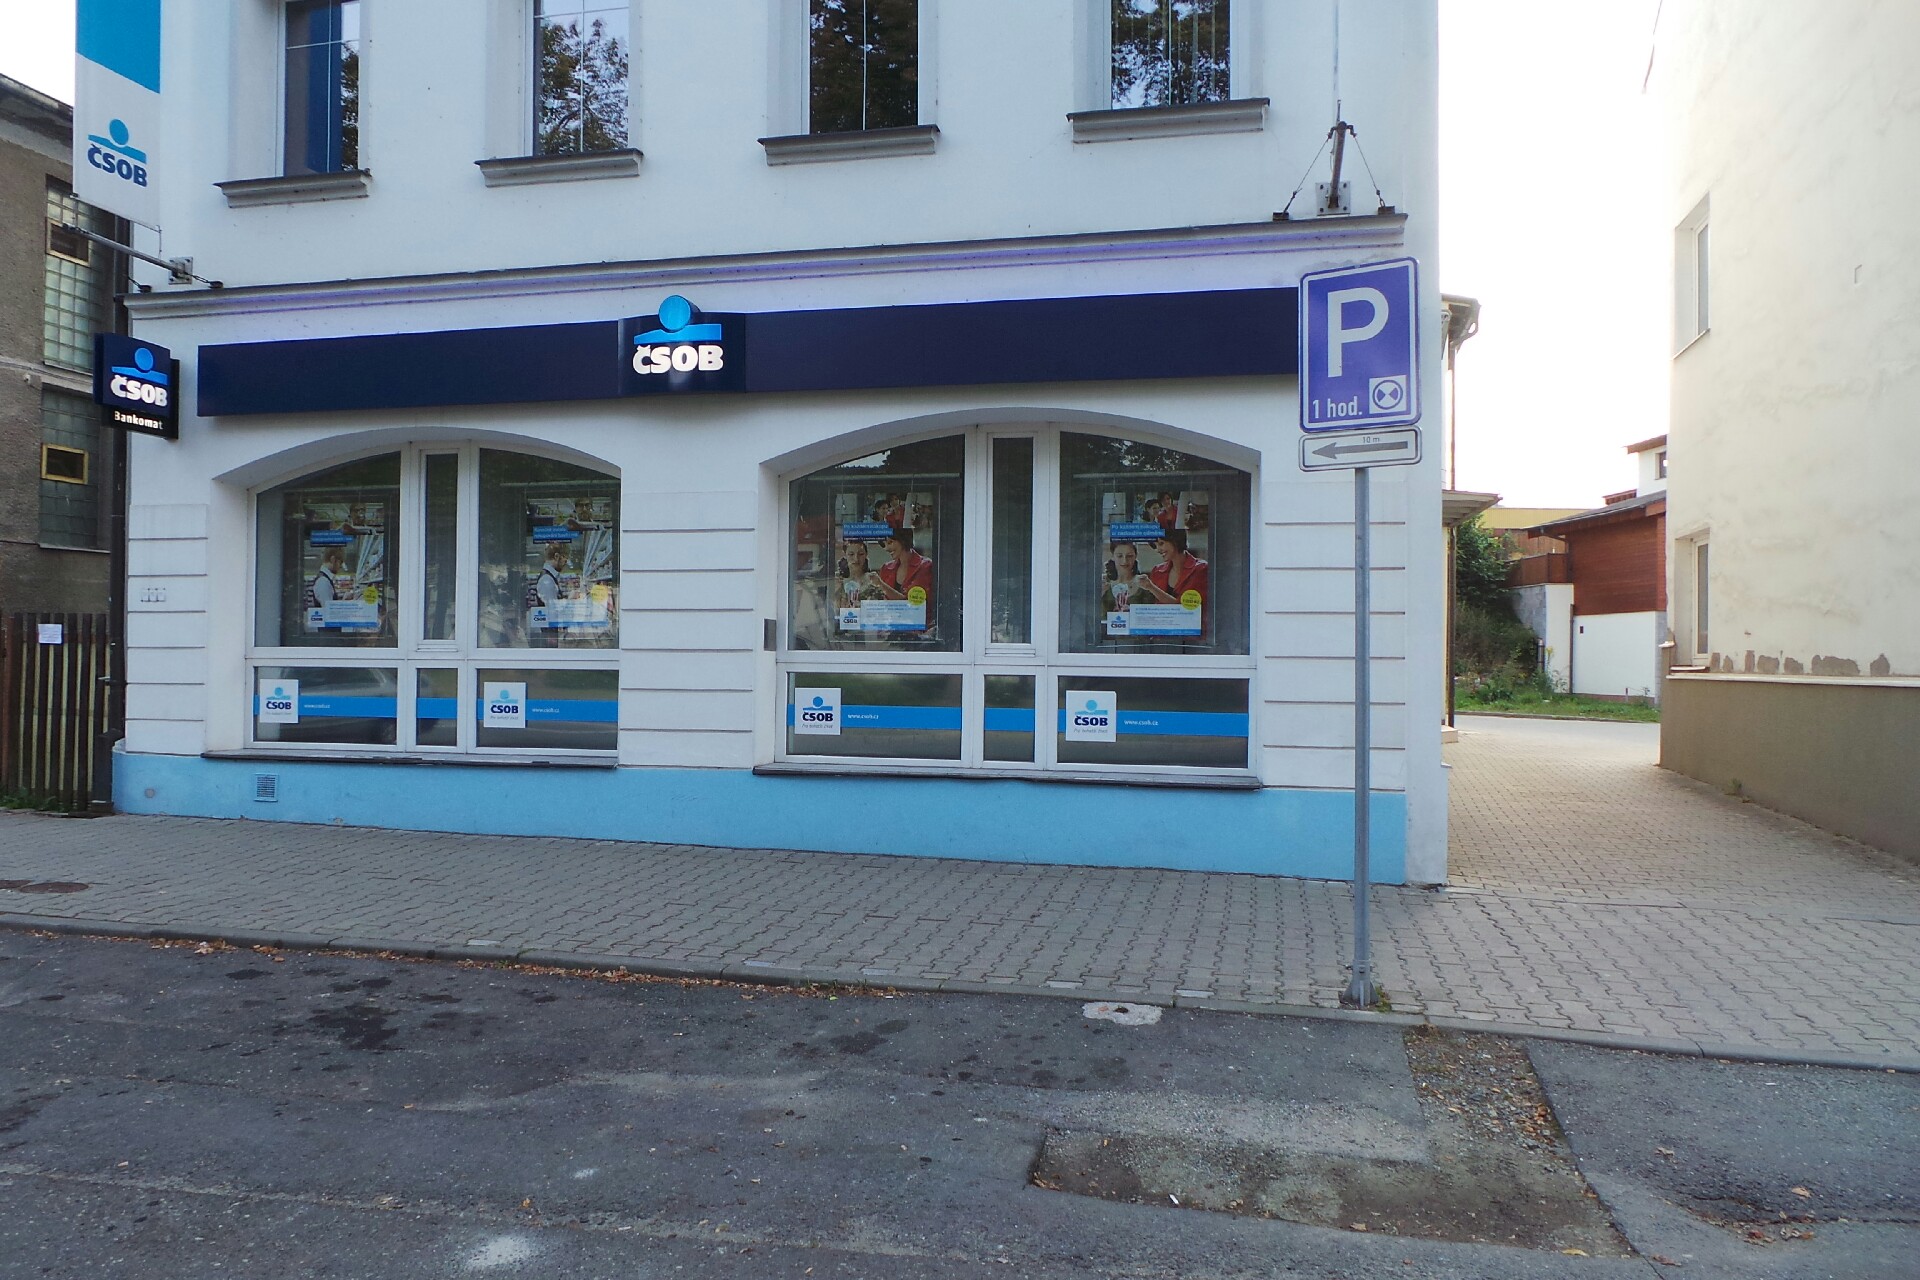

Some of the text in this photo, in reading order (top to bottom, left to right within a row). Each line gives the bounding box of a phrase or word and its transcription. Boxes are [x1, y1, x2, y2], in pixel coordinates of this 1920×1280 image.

[87, 143, 147, 188] ČSOB
[1327, 286, 1389, 378] P
[632, 345, 724, 374] ČSOB
[110, 374, 168, 407] ČSOB
[1312, 395, 1363, 419] 1 hod.
[114, 410, 164, 430] Bankomat
[1362, 436, 1371, 444] 10
[266, 700, 292, 710] ČSOB
[490, 704, 519, 714] ČSOB
[802, 711, 834, 722] ČSOB
[1074, 716, 1109, 727] ČSOB
